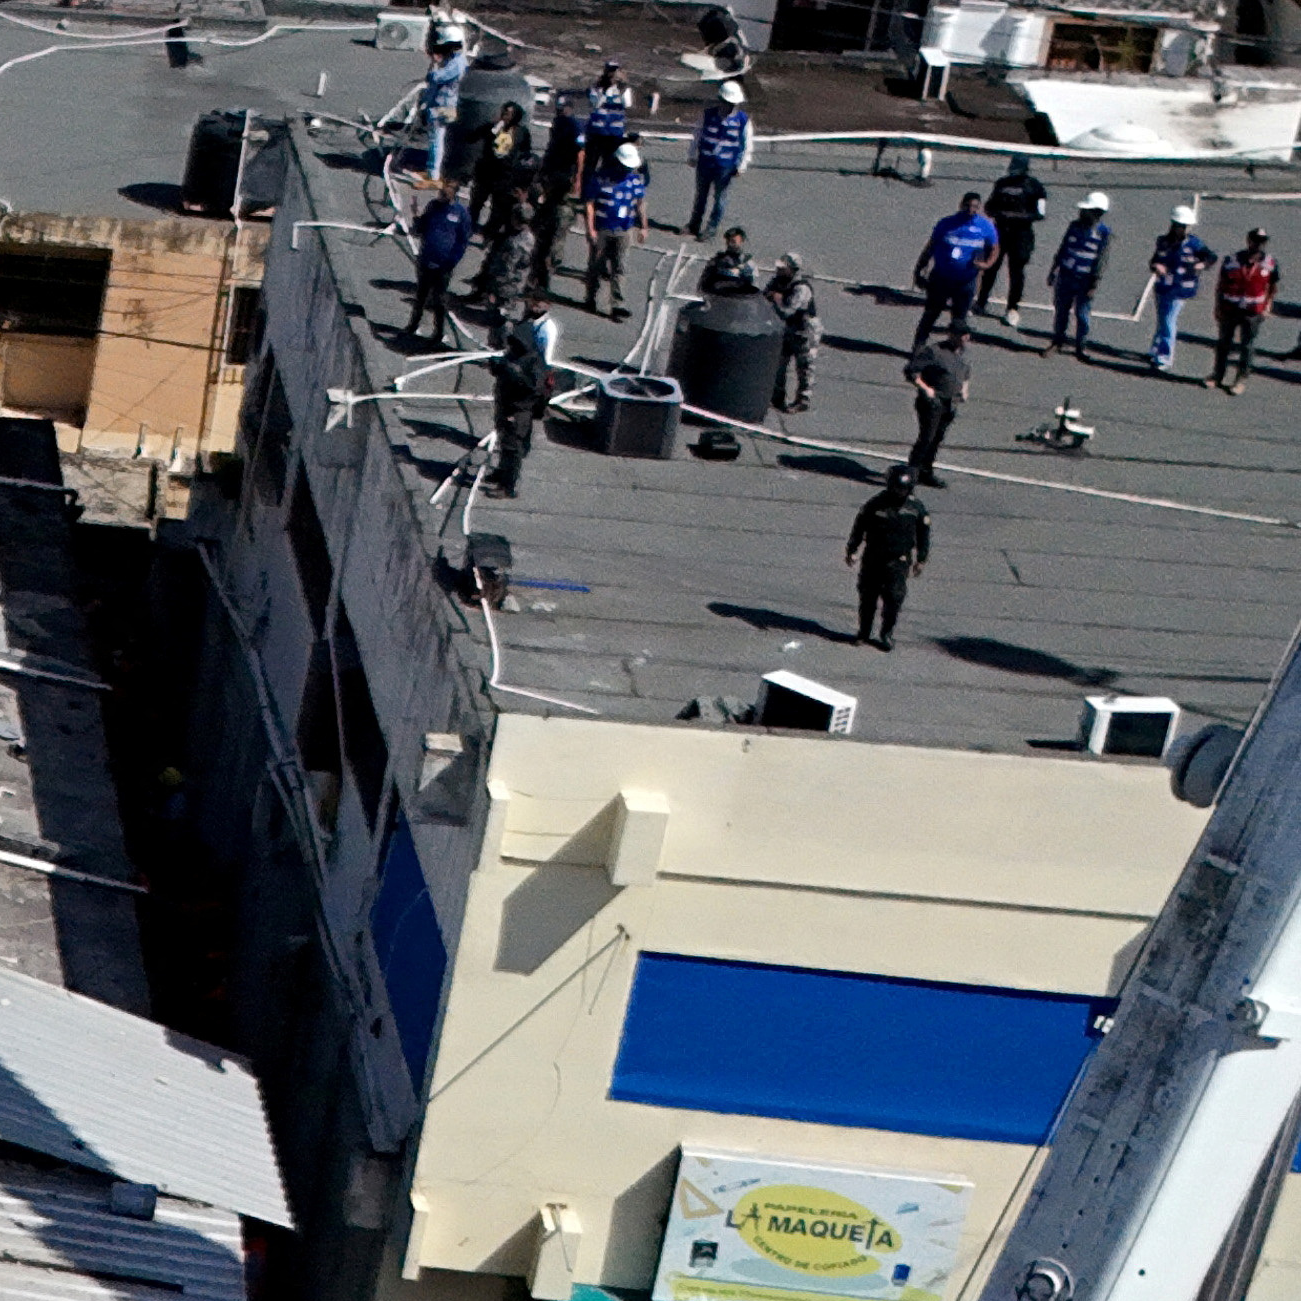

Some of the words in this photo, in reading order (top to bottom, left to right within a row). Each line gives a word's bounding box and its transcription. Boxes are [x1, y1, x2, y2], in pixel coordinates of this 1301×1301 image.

[724, 1202, 762, 1230] LA
[767, 1215, 895, 1249] MAQUETA
[753, 1235, 792, 1265] CENTRO
[794, 1260, 810, 1270] DE
